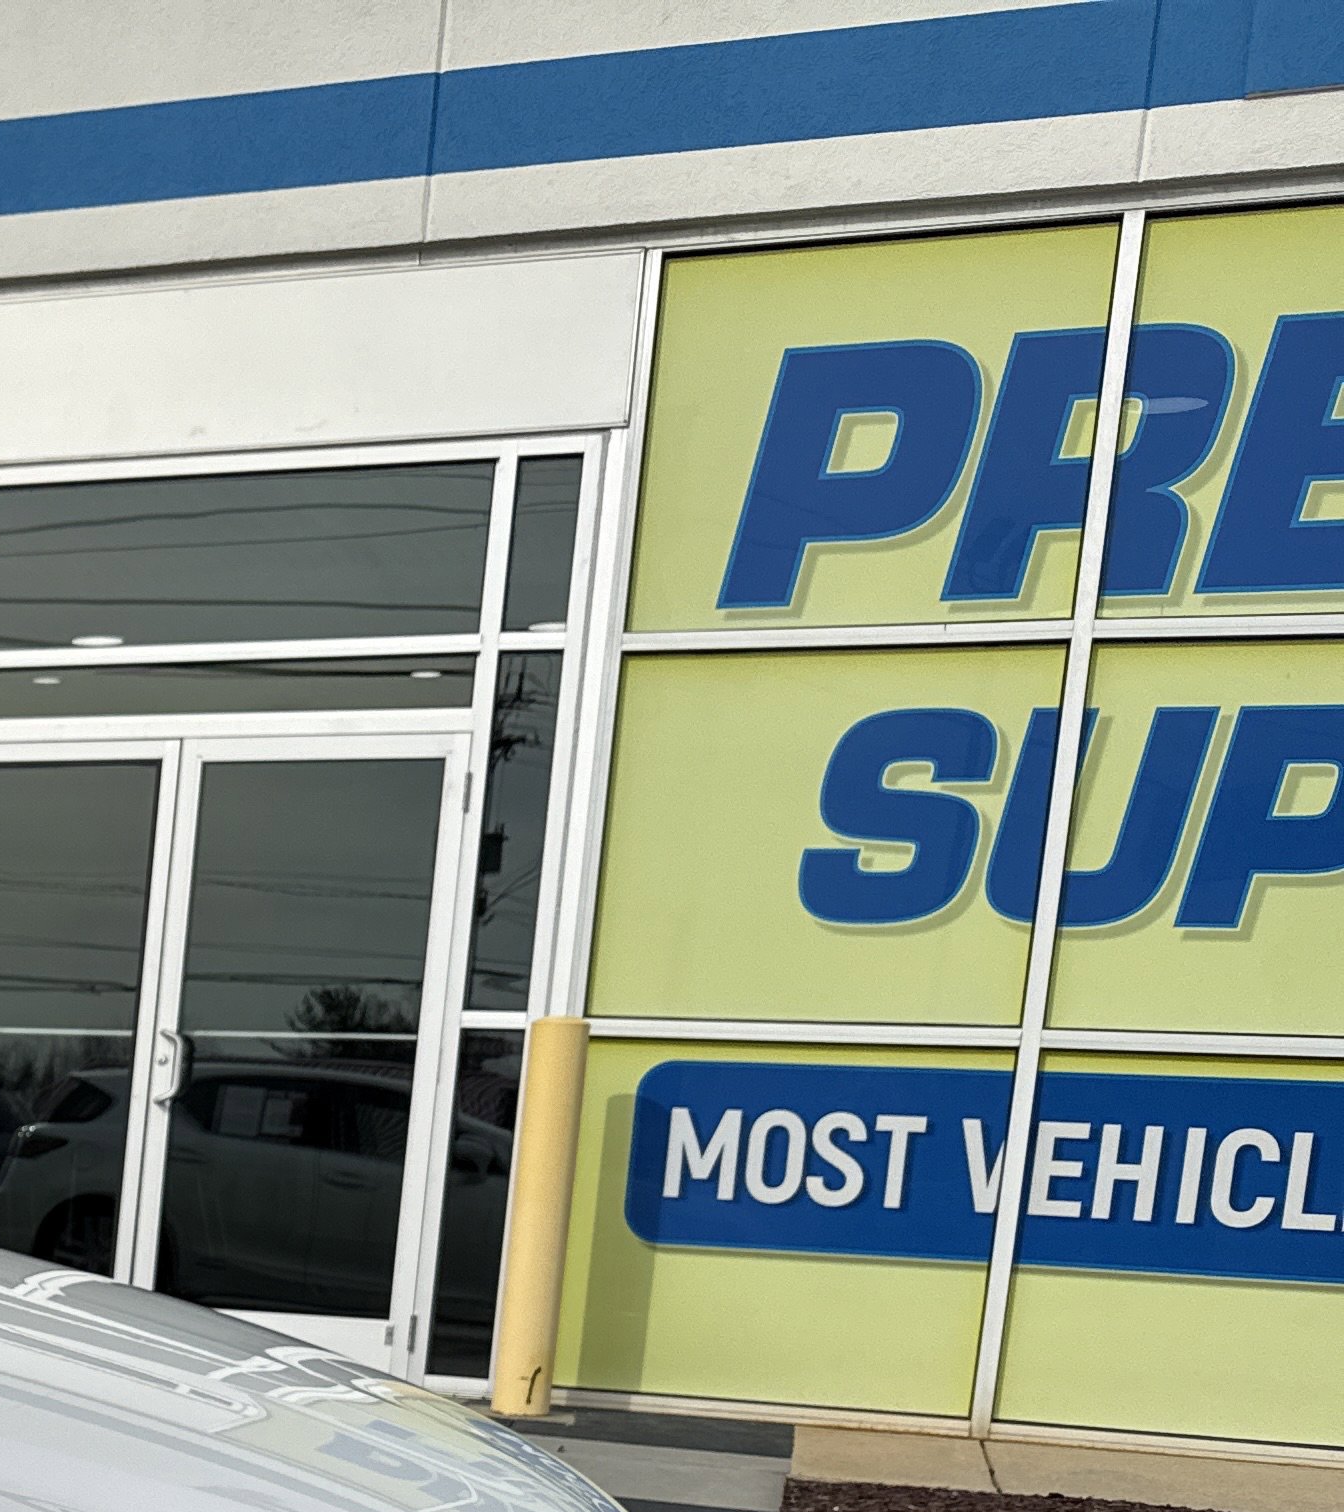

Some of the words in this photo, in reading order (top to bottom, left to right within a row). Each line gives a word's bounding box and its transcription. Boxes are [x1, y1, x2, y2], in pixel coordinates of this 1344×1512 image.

[717, 312, 1344, 608] PRE
[798, 705, 1344, 929] SUP
[662, 1107, 926, 1212] MOST
[962, 1118, 1344, 1232] VEHICL
